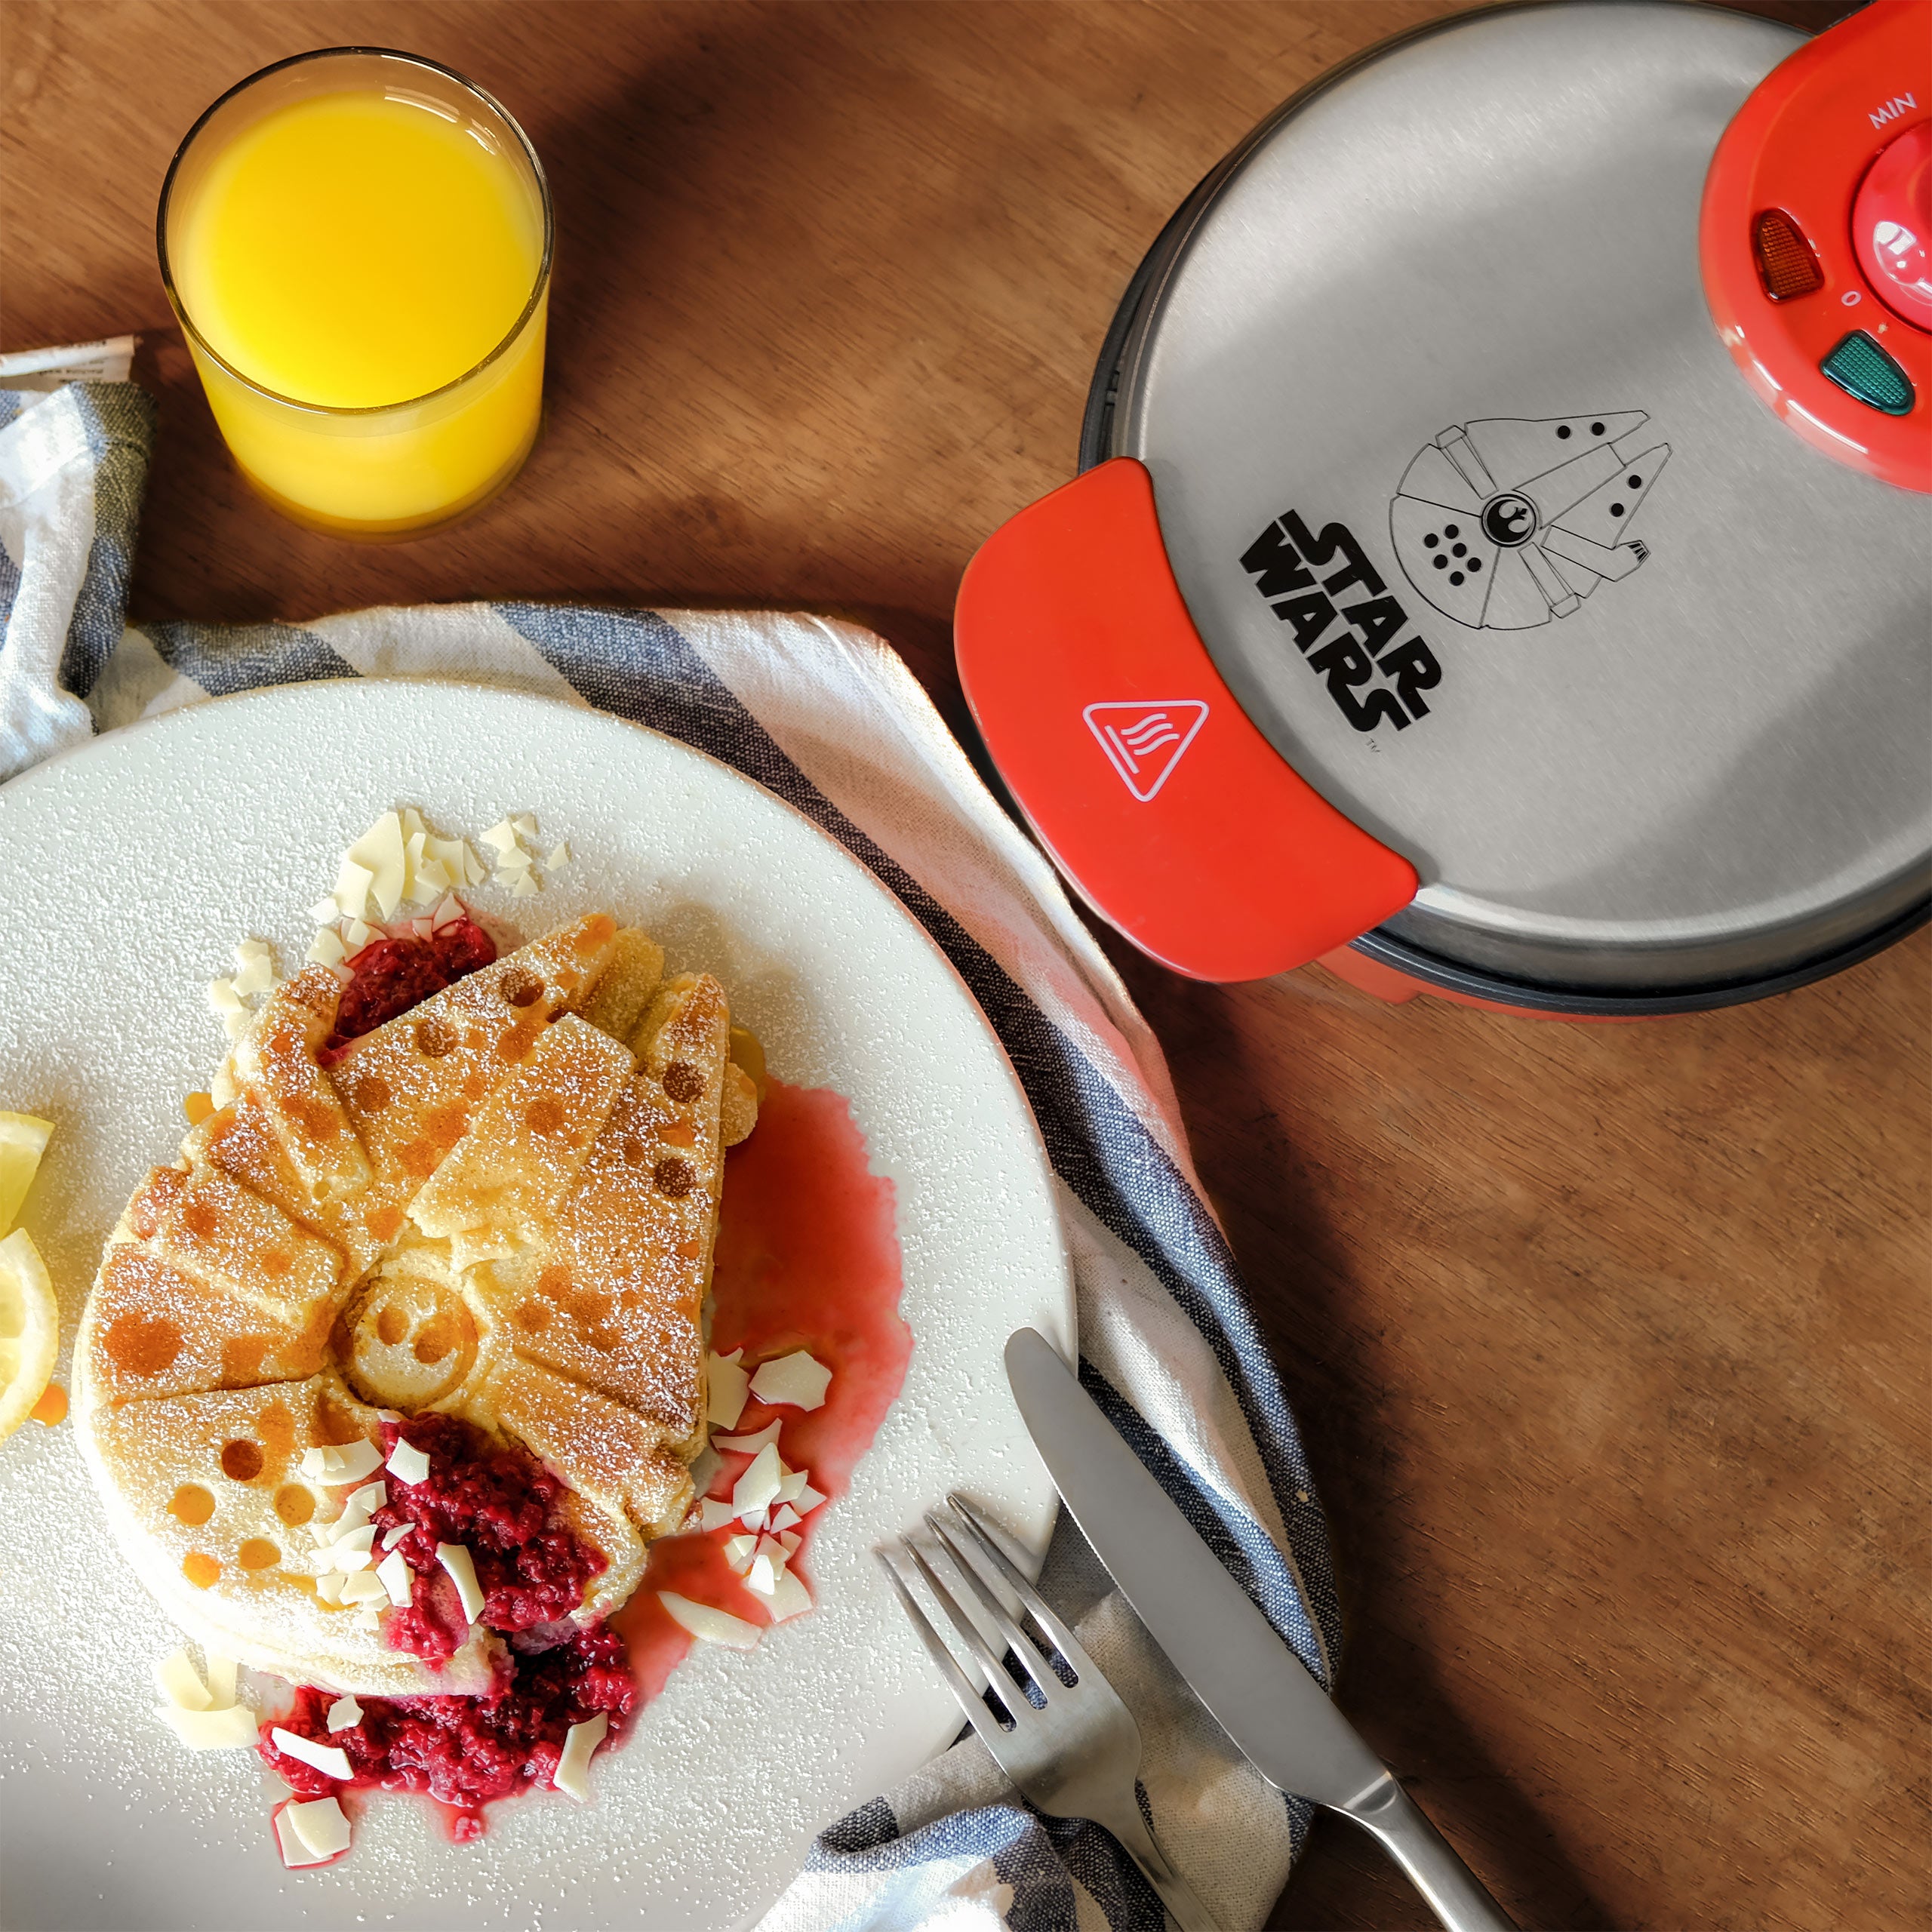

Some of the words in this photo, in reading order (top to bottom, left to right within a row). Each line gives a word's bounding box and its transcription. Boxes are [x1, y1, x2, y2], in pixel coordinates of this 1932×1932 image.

[1868, 91, 1917, 129] MIN
[1238, 520, 1411, 732] WARS
[1278, 509, 1441, 720] STAR
